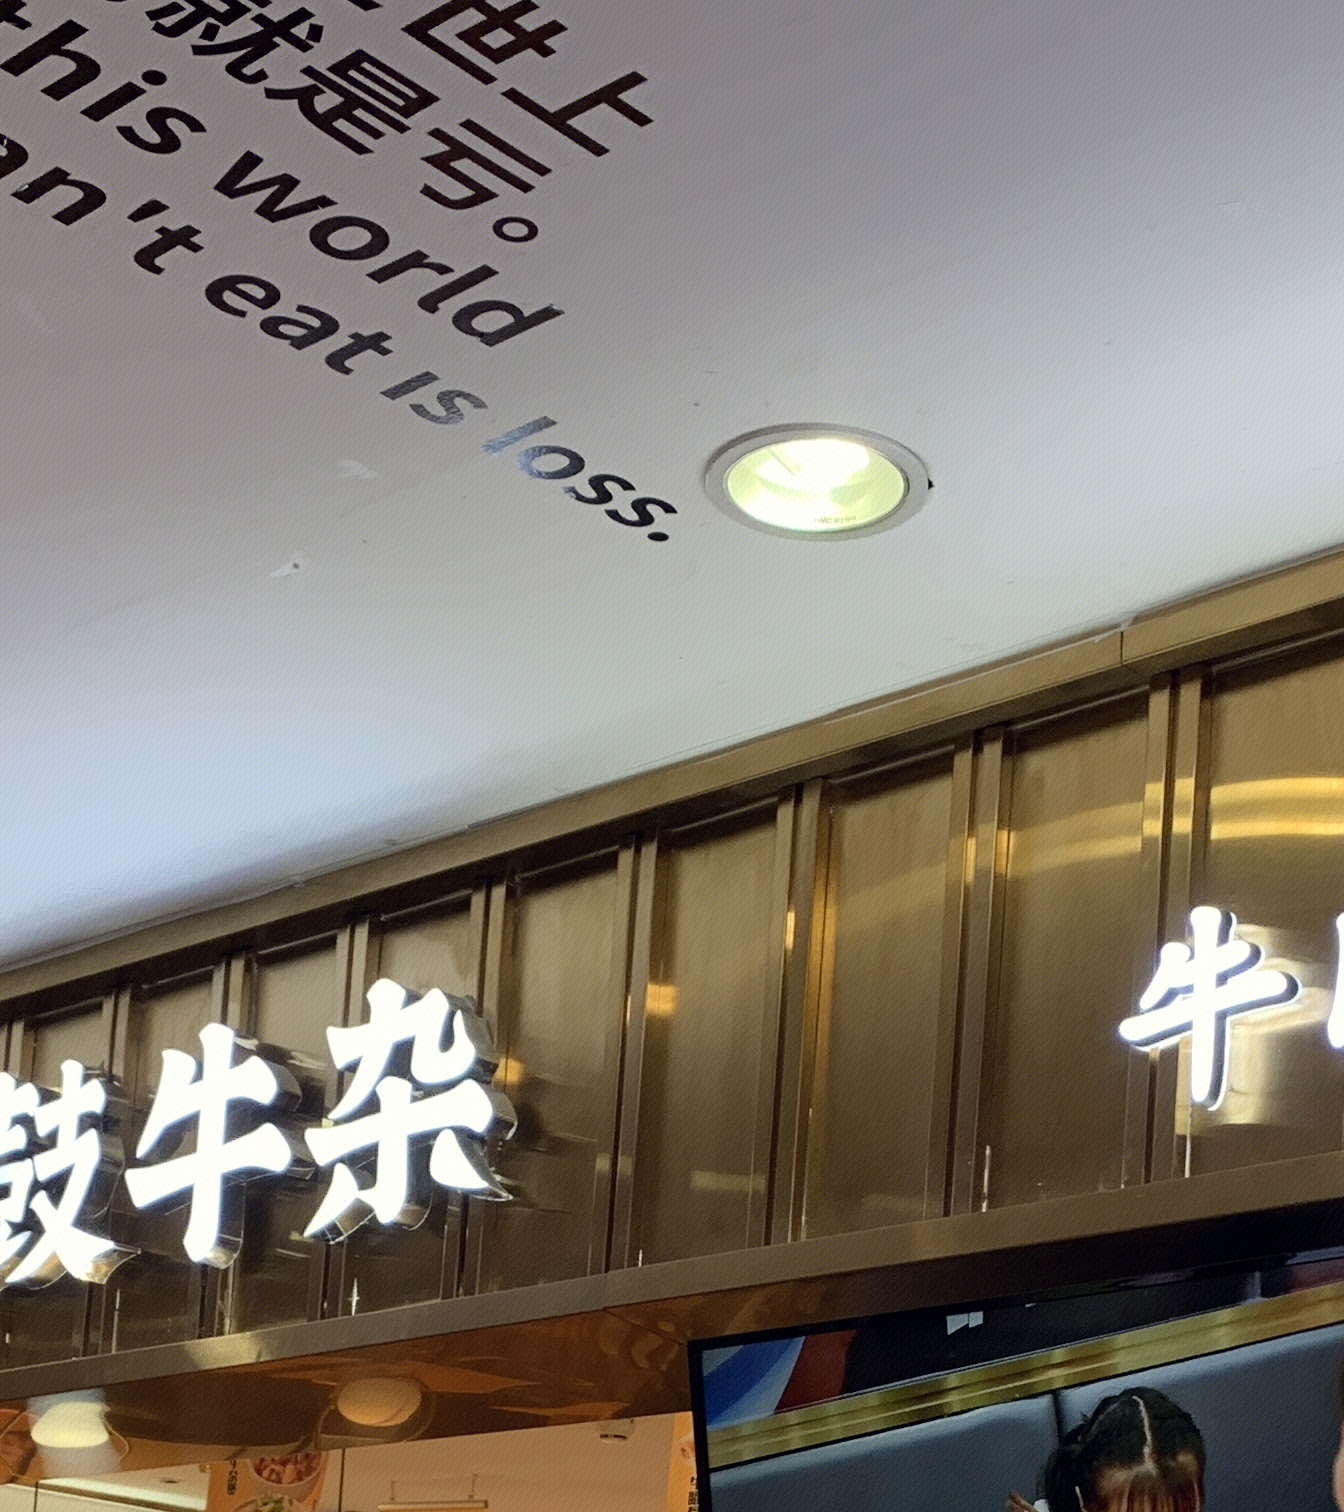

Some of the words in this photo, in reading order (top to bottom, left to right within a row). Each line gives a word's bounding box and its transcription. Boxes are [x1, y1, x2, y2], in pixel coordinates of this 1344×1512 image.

[213, 150, 564, 348] world
[204, 273, 392, 376] eat
[379, 370, 489, 426] is
[481, 416, 677, 544] loss.
